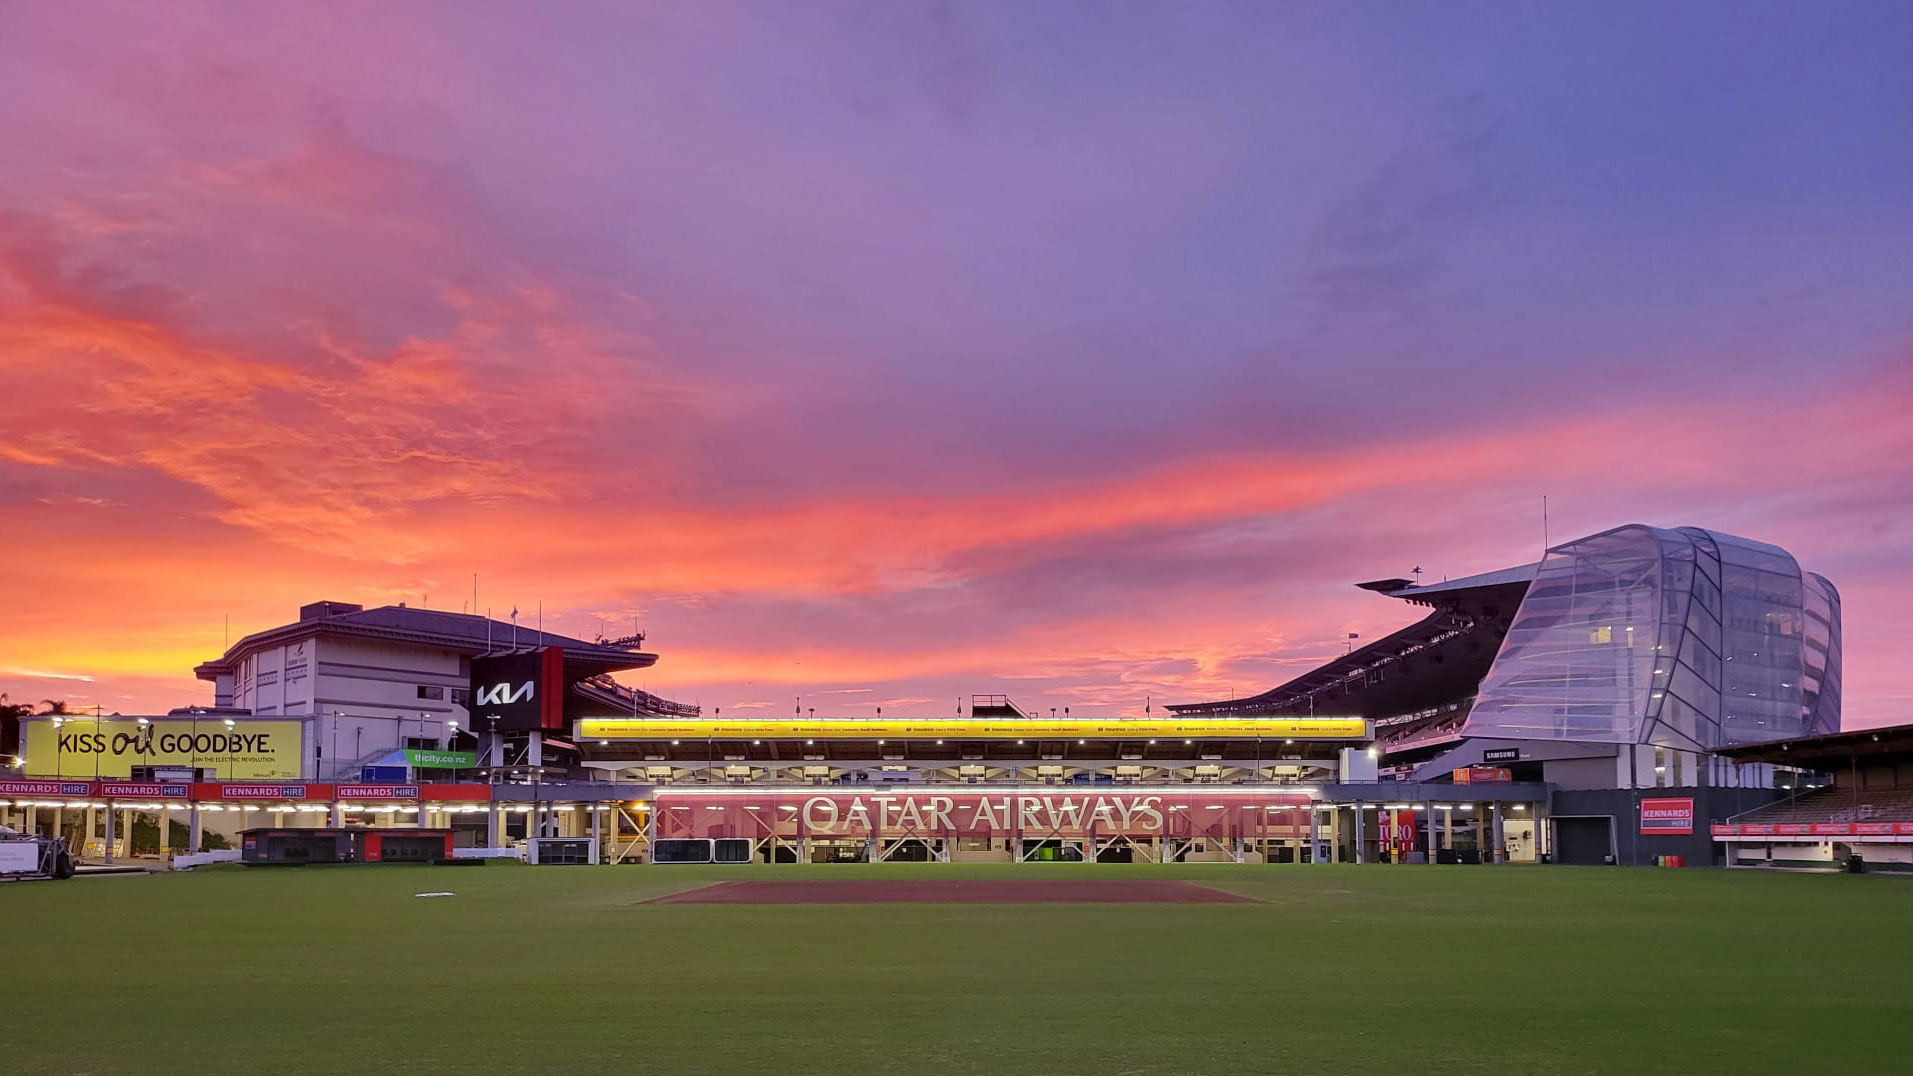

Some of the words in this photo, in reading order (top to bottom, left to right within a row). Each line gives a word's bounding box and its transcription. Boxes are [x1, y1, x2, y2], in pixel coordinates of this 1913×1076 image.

[58, 733, 106, 754] KISS
[112, 723, 156, 757] oil
[160, 733, 276, 754] GOODBYE.
[1486, 751, 1516, 759] SAMSUNG
[62, 783, 87, 794] HIRE
[104, 785, 160, 796] KENNARDS
[163, 787, 186, 796] HIRE
[225, 787, 279, 796] KENNARDS
[282, 787, 304, 796] HIRE
[340, 787, 393, 796] KENNARDS
[395, 788, 416, 797] HIRE
[802, 796, 957, 833] QATAR
[969, 796, 1164, 830] AIRWAYS
[1644, 809, 1690, 818] KENNARDS
